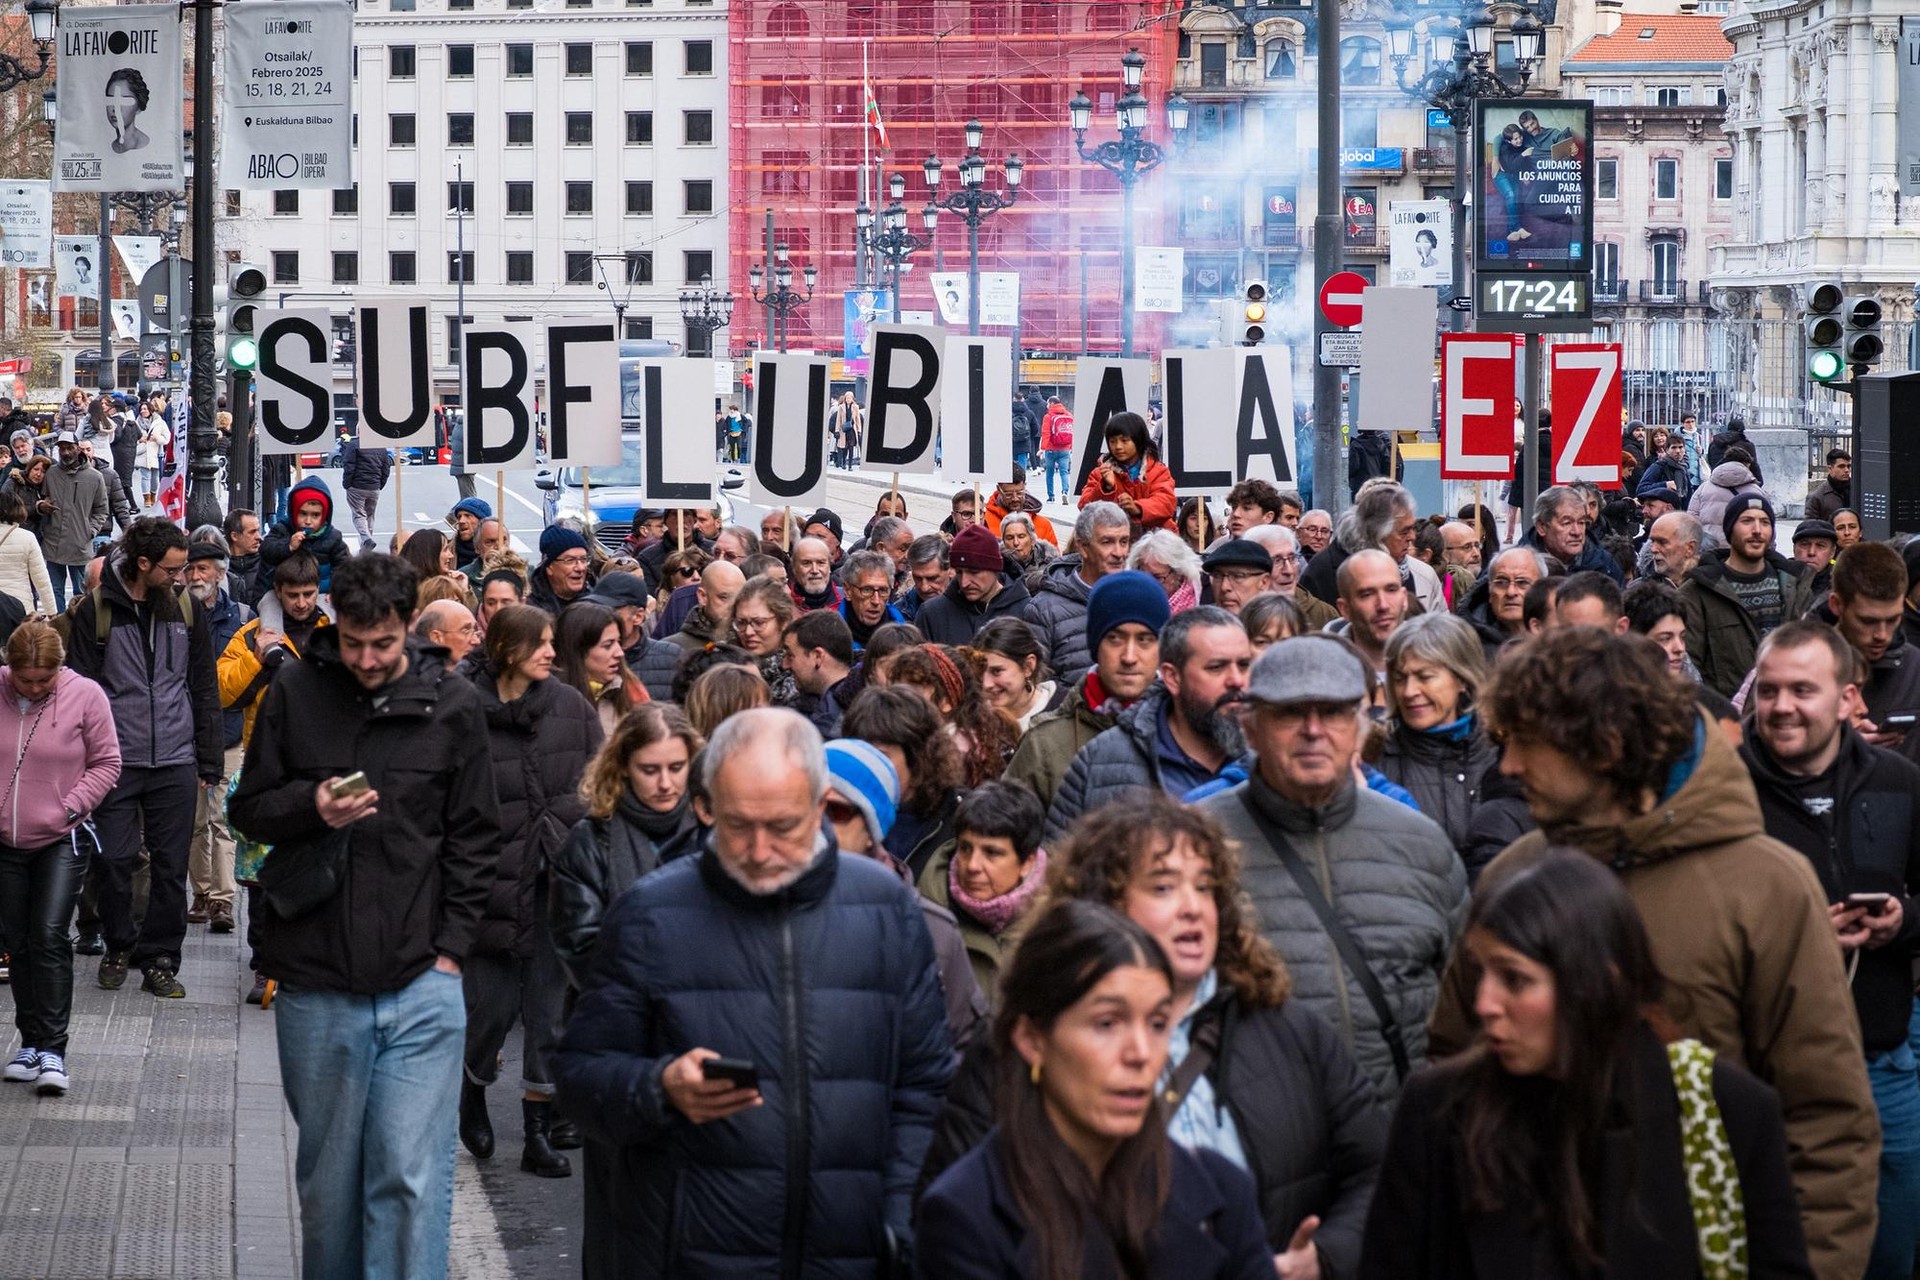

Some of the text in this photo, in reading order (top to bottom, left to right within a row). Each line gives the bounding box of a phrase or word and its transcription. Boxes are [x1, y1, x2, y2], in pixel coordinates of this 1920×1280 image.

[265, 22, 274, 34] LA
[66, 32, 80, 56] LA
[264, 50, 313, 62] Otsailak/
[252, 66, 323, 78] Febrero 2025
[245, 81, 332, 97] 15, 18, 21, 24
[255, 115, 333, 126] Euskalduna Bilbao
[304, 153, 328, 165] BILBAO
[1339, 150, 1375, 166] global
[248, 153, 299, 179] ABAO
[1536, 160, 1582, 170] CUIDAMOS
[304, 166, 326, 178] OPERA
[1519, 171, 1582, 180] LOS ANUNCIOS
[1558, 182, 1582, 192] PARA
[1539, 193, 1581, 204] CUIDARTE
[1279, 201, 1294, 214] EA
[1358, 203, 1374, 215] EA
[1564, 205, 1581, 215] A TI
[1394, 213, 1403, 224] LA
[1490, 280, 1578, 312] 17:24
